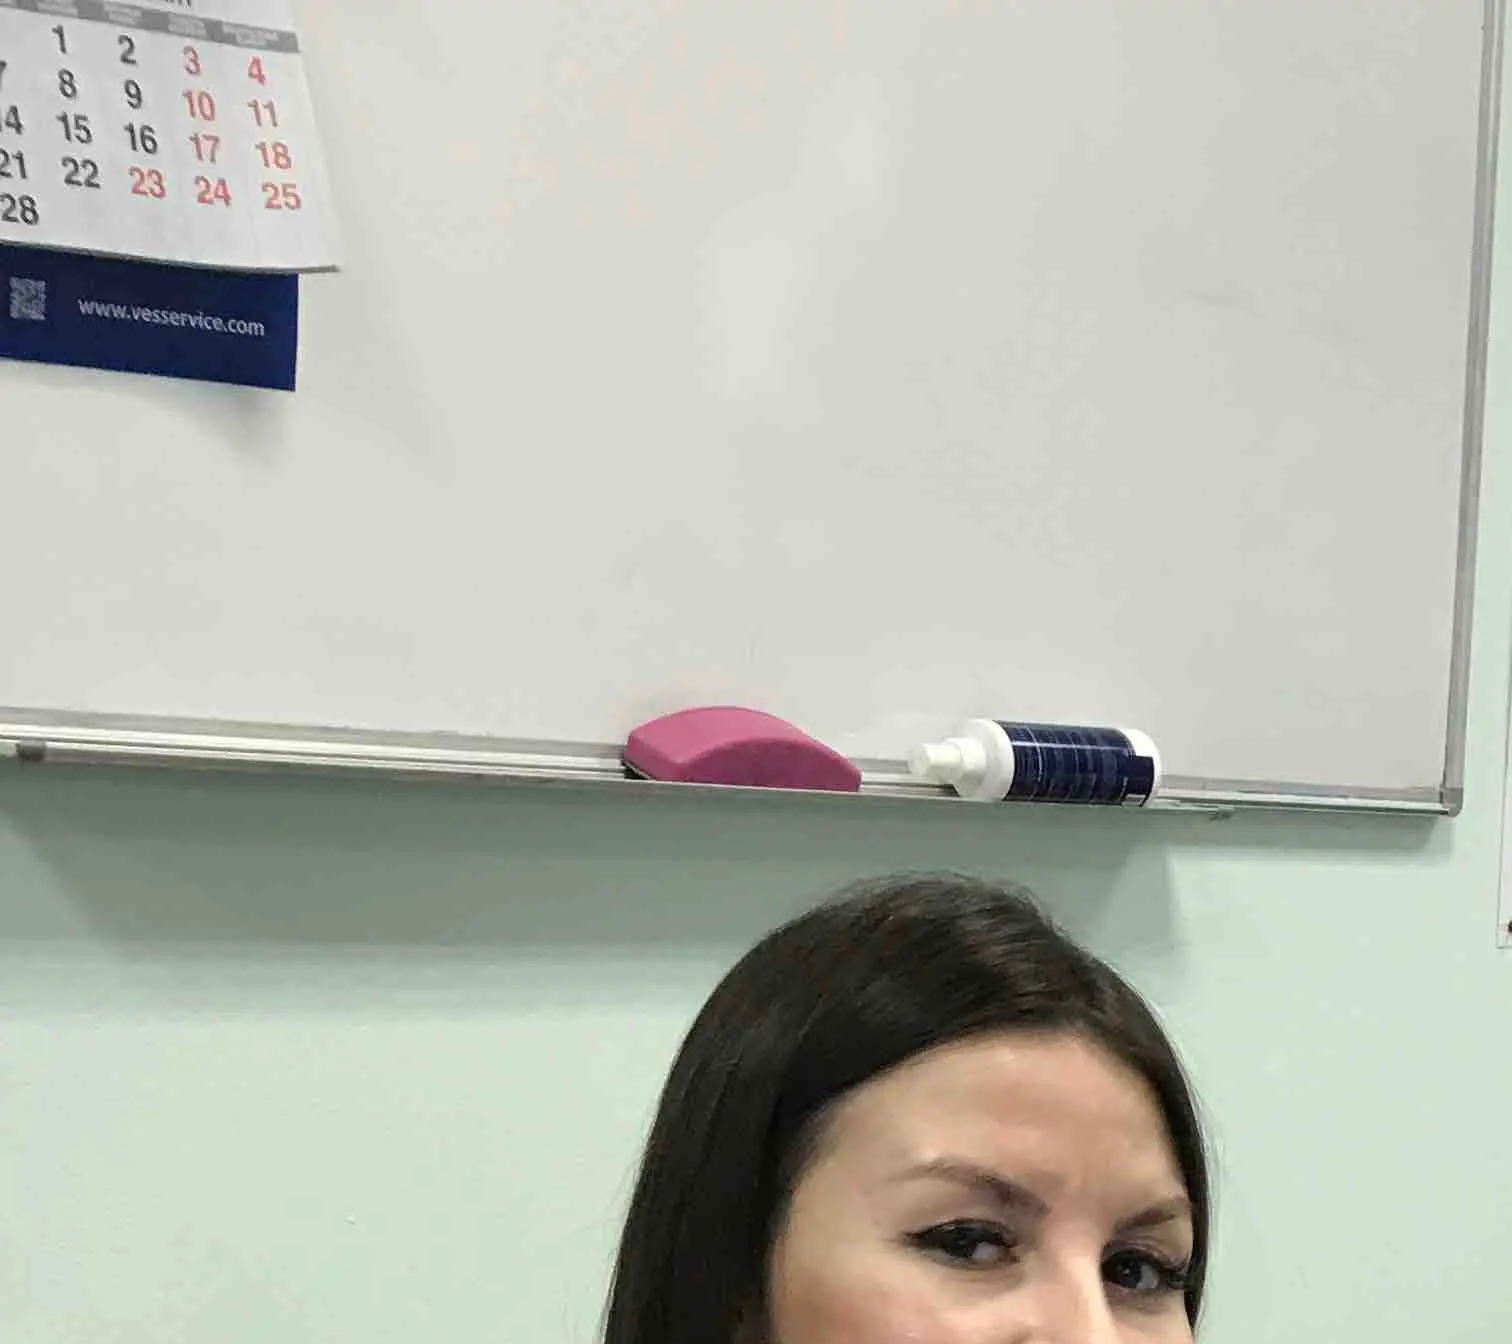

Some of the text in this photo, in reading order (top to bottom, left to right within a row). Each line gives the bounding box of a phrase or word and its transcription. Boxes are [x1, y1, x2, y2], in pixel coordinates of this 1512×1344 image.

[52, 25, 265, 85] 1 2 3 4
[58, 69, 278, 127] 8 9 10 11
[0, 105, 291, 169] 4 15 16 17 18
[0, 194, 39, 225] 28
[61, 157, 101, 189] 22
[129, 167, 166, 199] 23
[195, 176, 232, 207] 24
[262, 183, 301, 210] 25
[77, 297, 265, 338] www.vesservice.com
